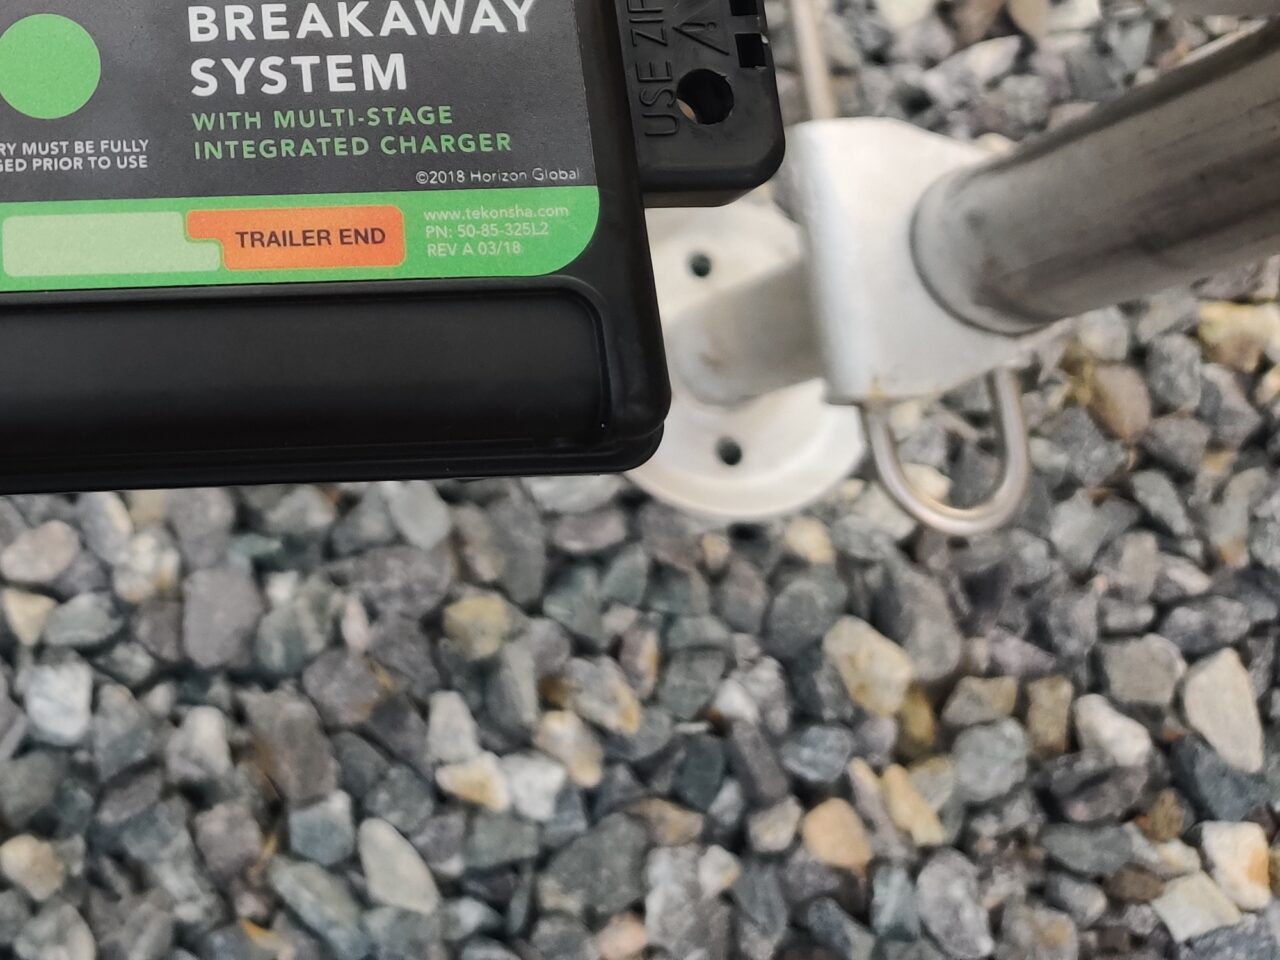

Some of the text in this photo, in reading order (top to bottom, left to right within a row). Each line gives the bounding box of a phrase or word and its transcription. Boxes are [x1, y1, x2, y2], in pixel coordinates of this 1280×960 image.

[190, 53, 408, 97] SYSTEM
[635, 60, 680, 138] USE
[191, 105, 453, 132] WITH MULTI-STAGE
[21, 142, 70, 156] MUST
[74, 141, 95, 155] BE
[100, 139, 149, 154] FULLY
[194, 133, 512, 160] INTEGRATED CHARGER
[32, 157, 84, 172] PRIOR
[87, 156, 111, 171] TO
[116, 155, 148, 169] USE
[470, 169, 527, 183] Horizon
[531, 167, 580, 181] Global
[423, 205, 569, 221] www.tekonsha.com
[235, 227, 386, 248] TRAILER END
[425, 222, 549, 239] PN: 50-85-325L2
[427, 240, 523, 257] REV A 03/18
